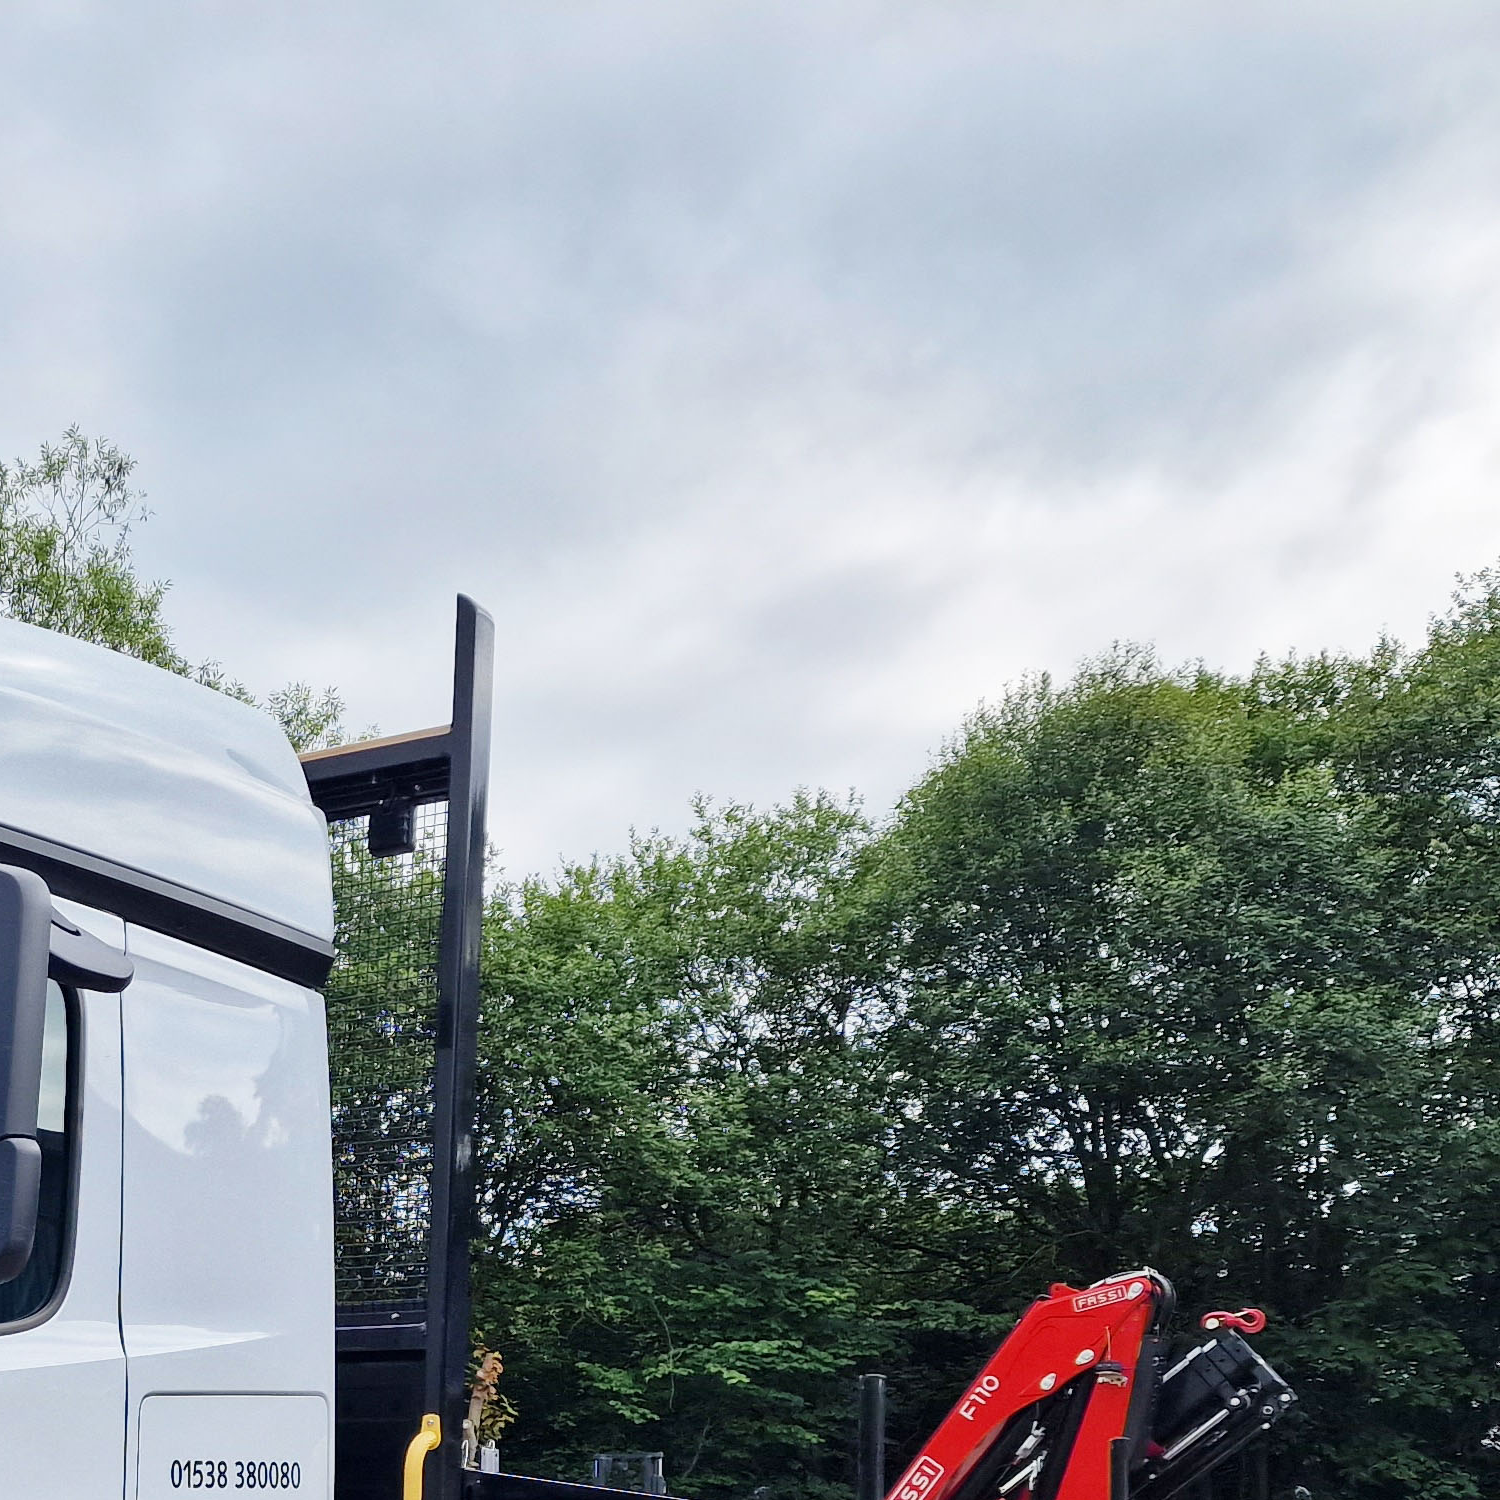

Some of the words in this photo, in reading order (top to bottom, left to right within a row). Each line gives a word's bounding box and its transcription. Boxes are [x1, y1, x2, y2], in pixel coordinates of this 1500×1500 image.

[1077, 1288, 1123, 1309] FASSI
[959, 1375, 1000, 1421] F110
[170, 1459, 228, 1489] 01538
[234, 1460, 301, 1489] 380080
